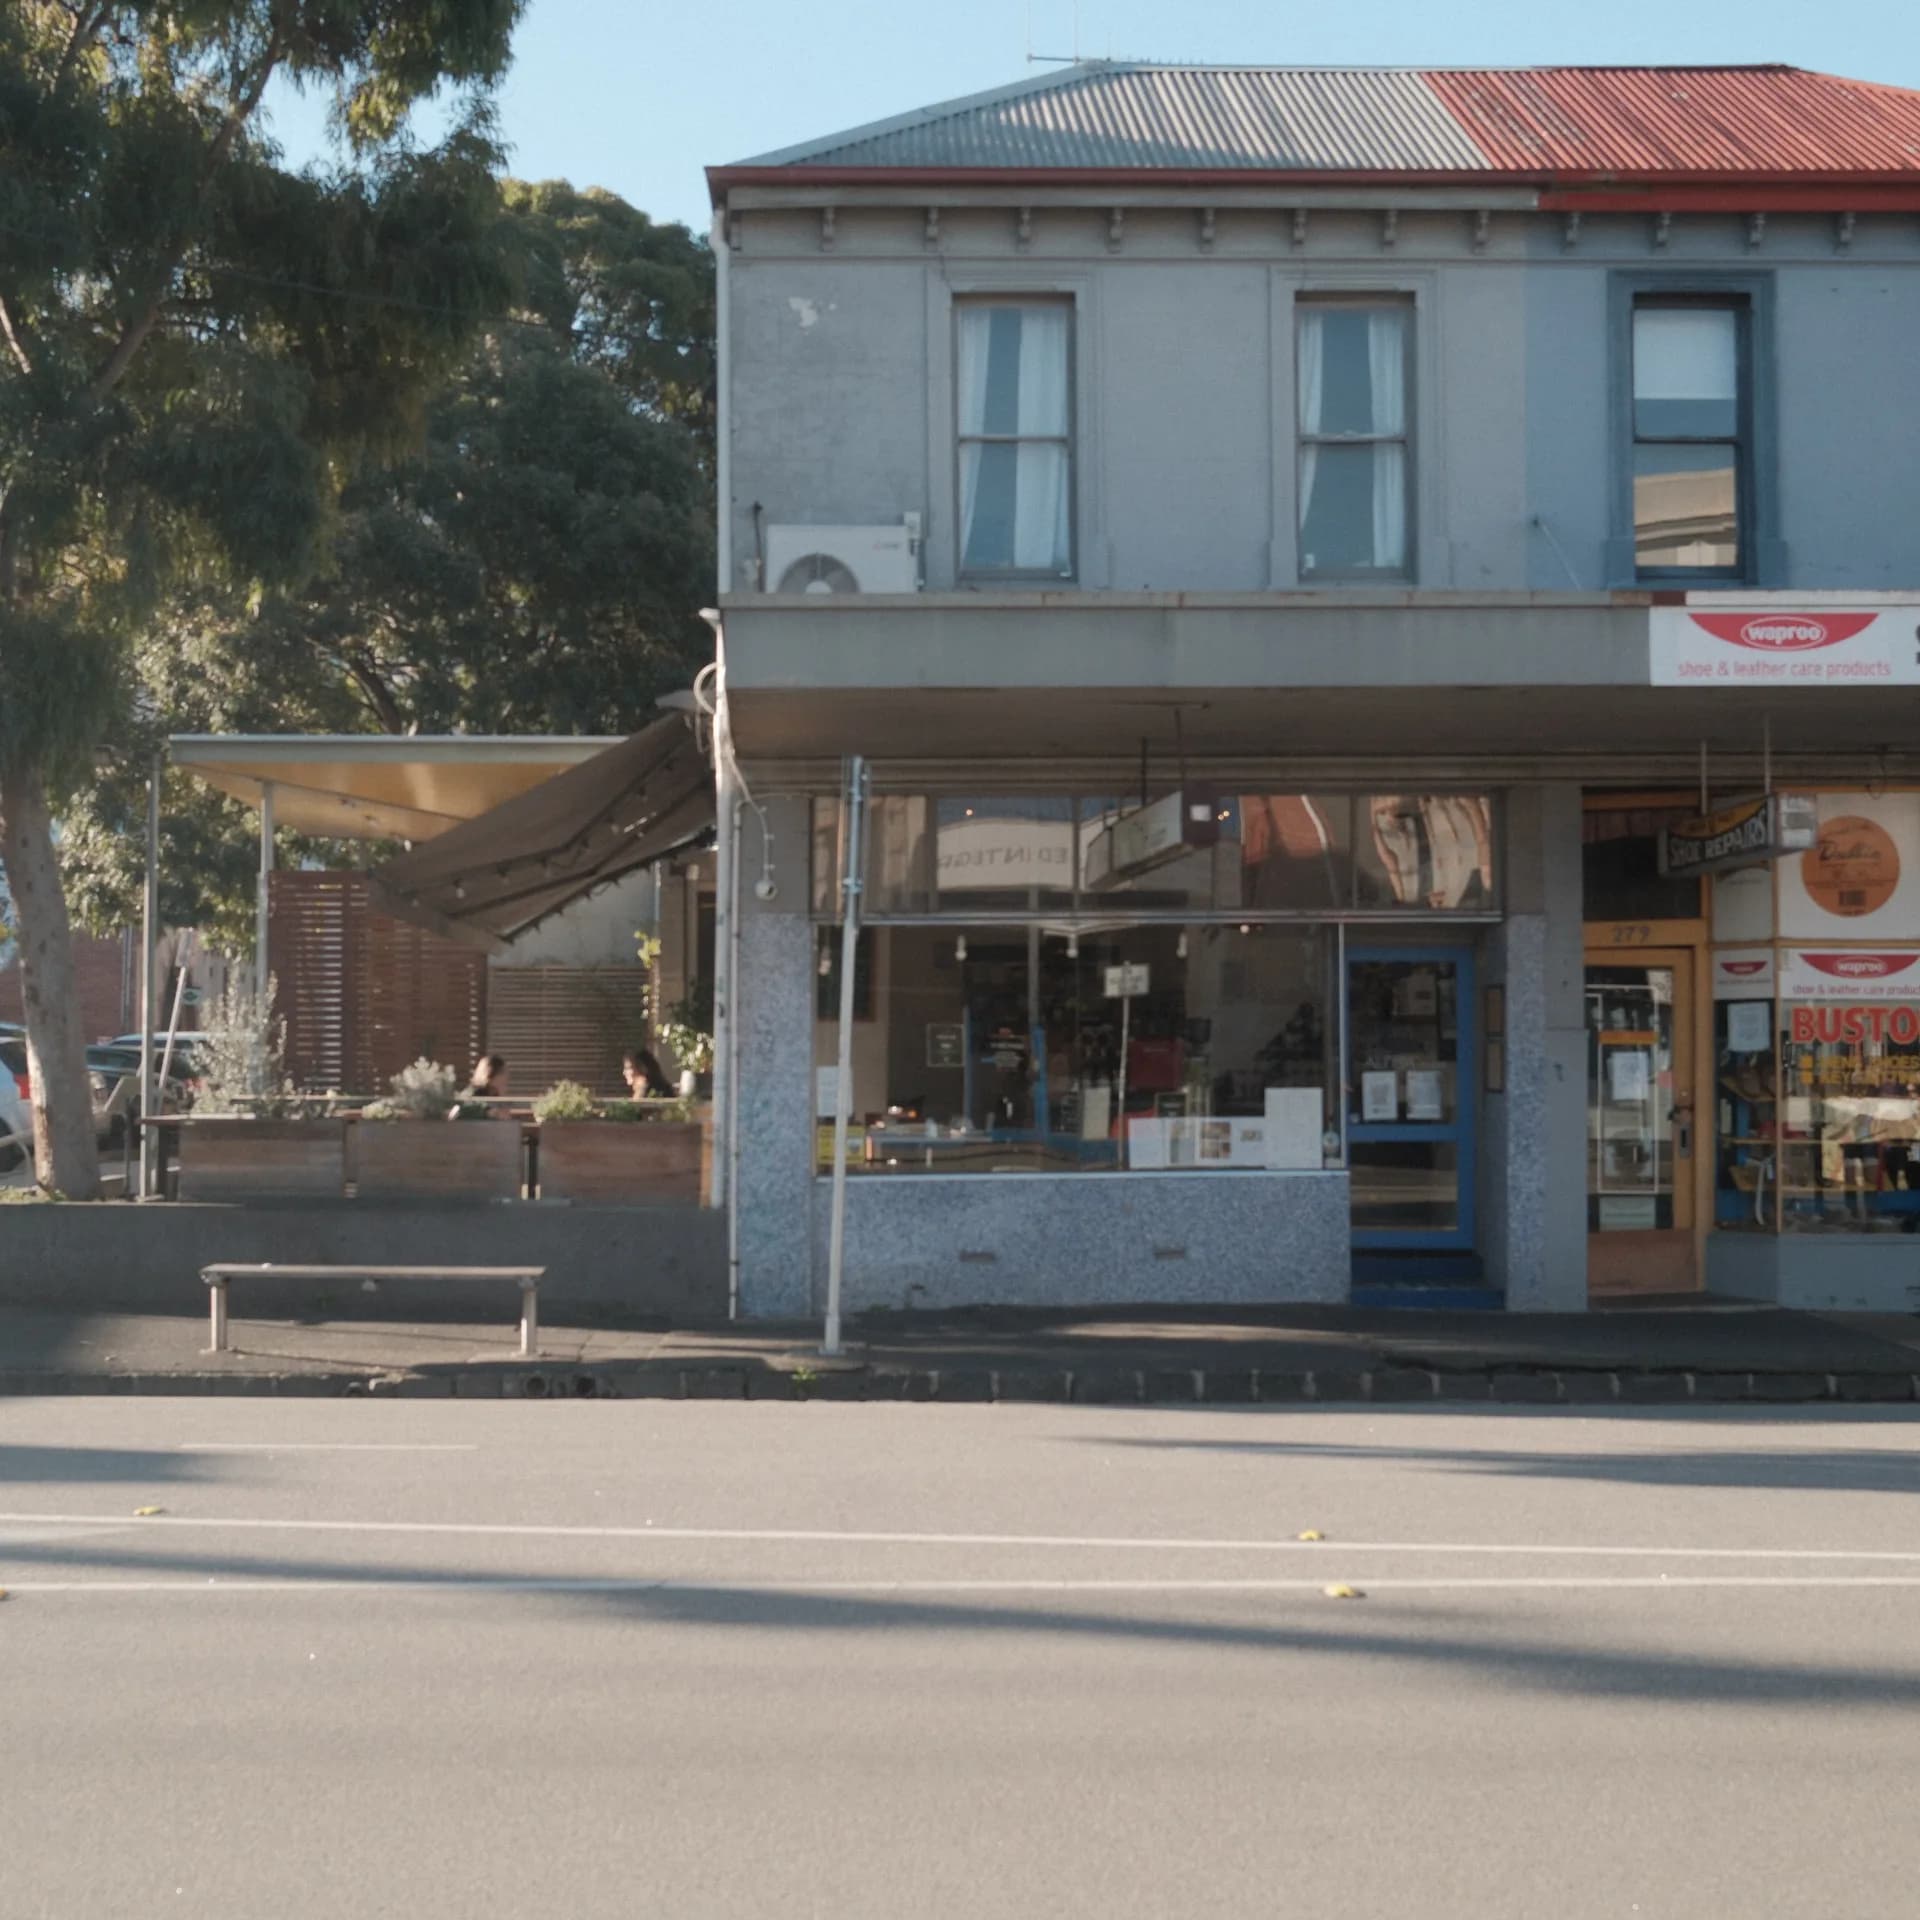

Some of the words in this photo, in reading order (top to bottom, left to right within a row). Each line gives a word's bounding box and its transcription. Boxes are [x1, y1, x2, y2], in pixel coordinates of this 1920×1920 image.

[1748, 626, 1821, 645] waproo
[1678, 661, 1713, 677] shoe
[1717, 661, 1730, 677] &
[1734, 661, 1786, 677] leather
[1790, 664, 1825, 677] care
[1826, 661, 1891, 681] products
[1705, 808, 1767, 858] REPAIRS
